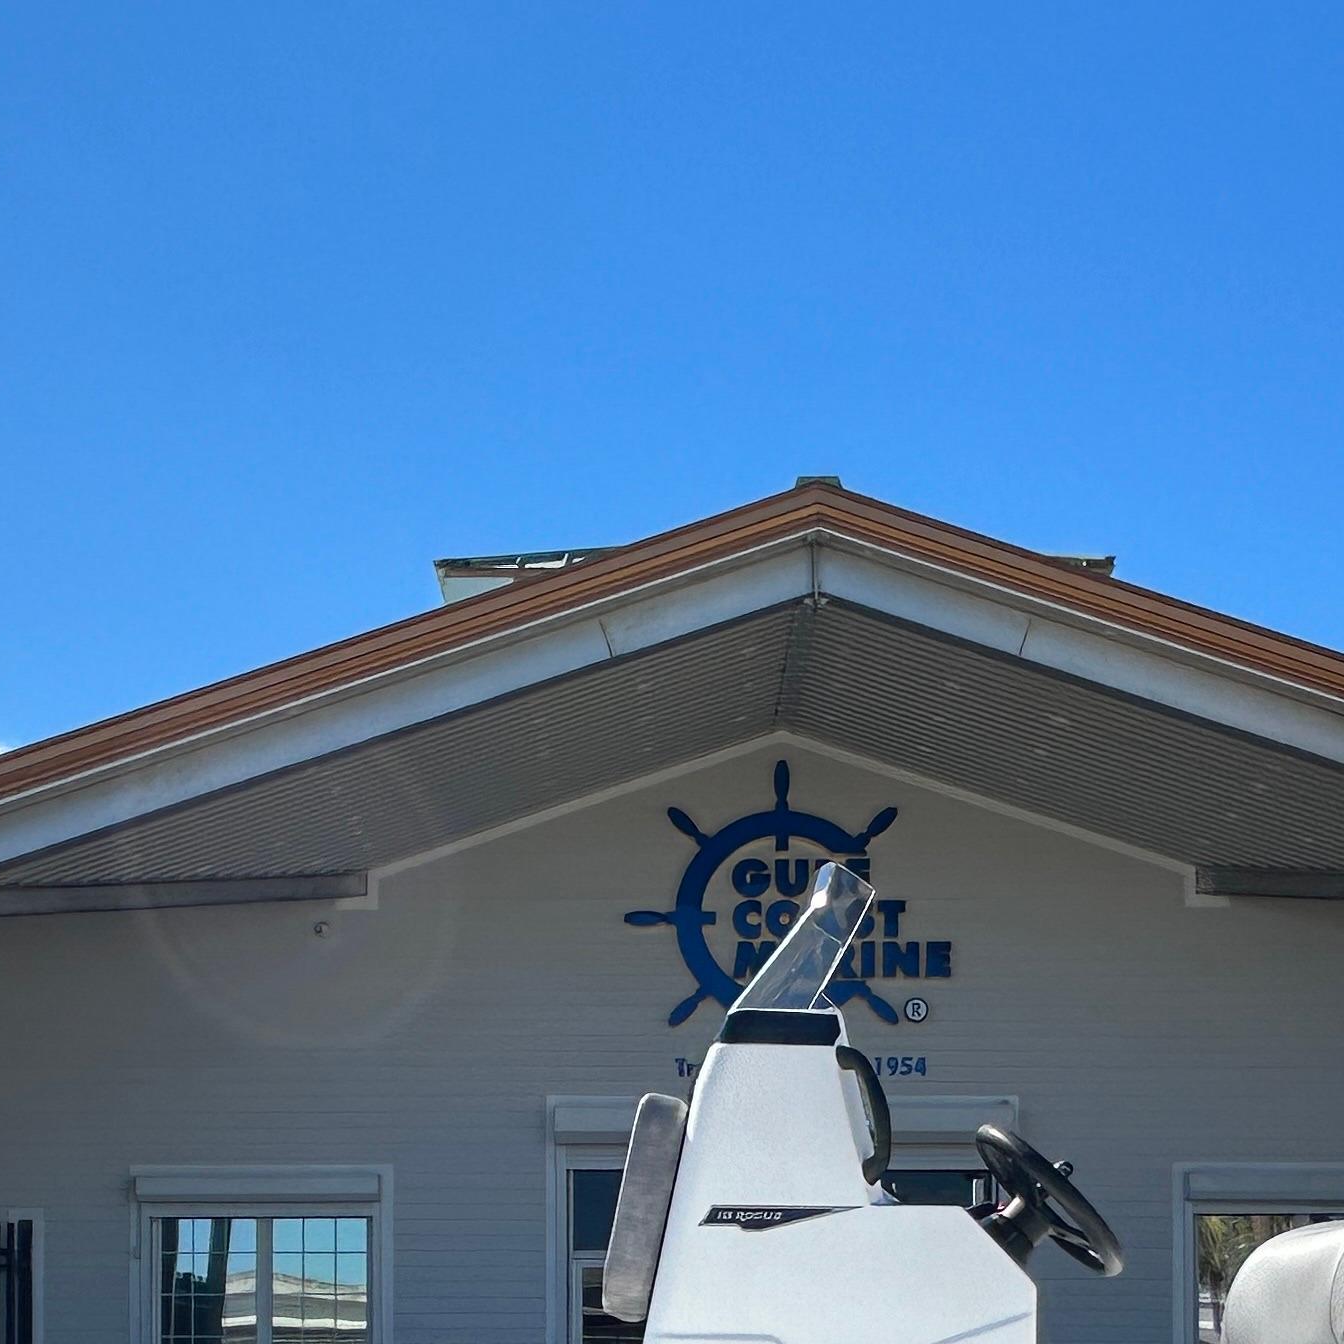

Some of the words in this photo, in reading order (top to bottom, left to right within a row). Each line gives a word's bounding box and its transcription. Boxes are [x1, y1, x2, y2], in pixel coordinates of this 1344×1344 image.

[731, 857, 871, 898] GUF
[733, 940, 952, 979] MRINE
[874, 1056, 928, 1077] 1954
